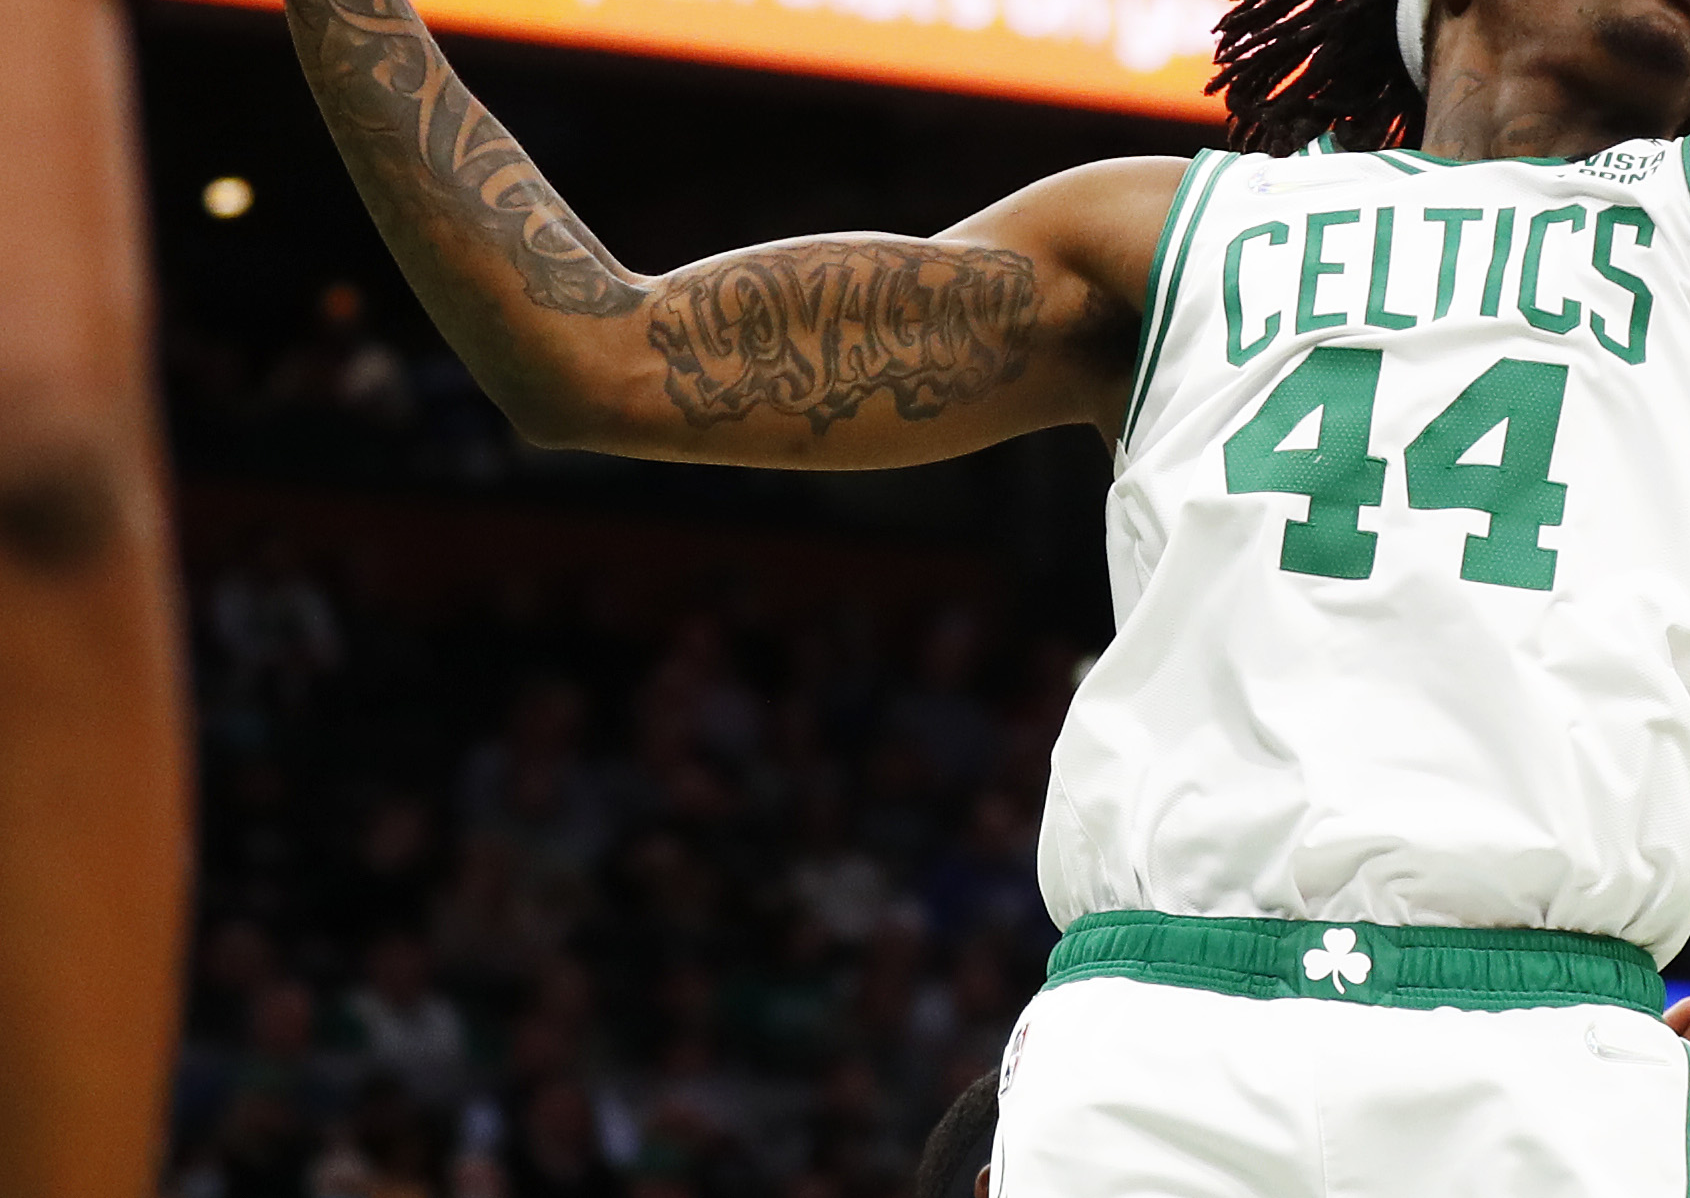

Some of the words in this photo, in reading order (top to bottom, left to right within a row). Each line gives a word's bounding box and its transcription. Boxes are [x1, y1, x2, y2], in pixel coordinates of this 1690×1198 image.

[1584, 150, 1667, 171] VISTA
[1223, 204, 1656, 368] CELTICS
[1223, 346, 1569, 592] 44
